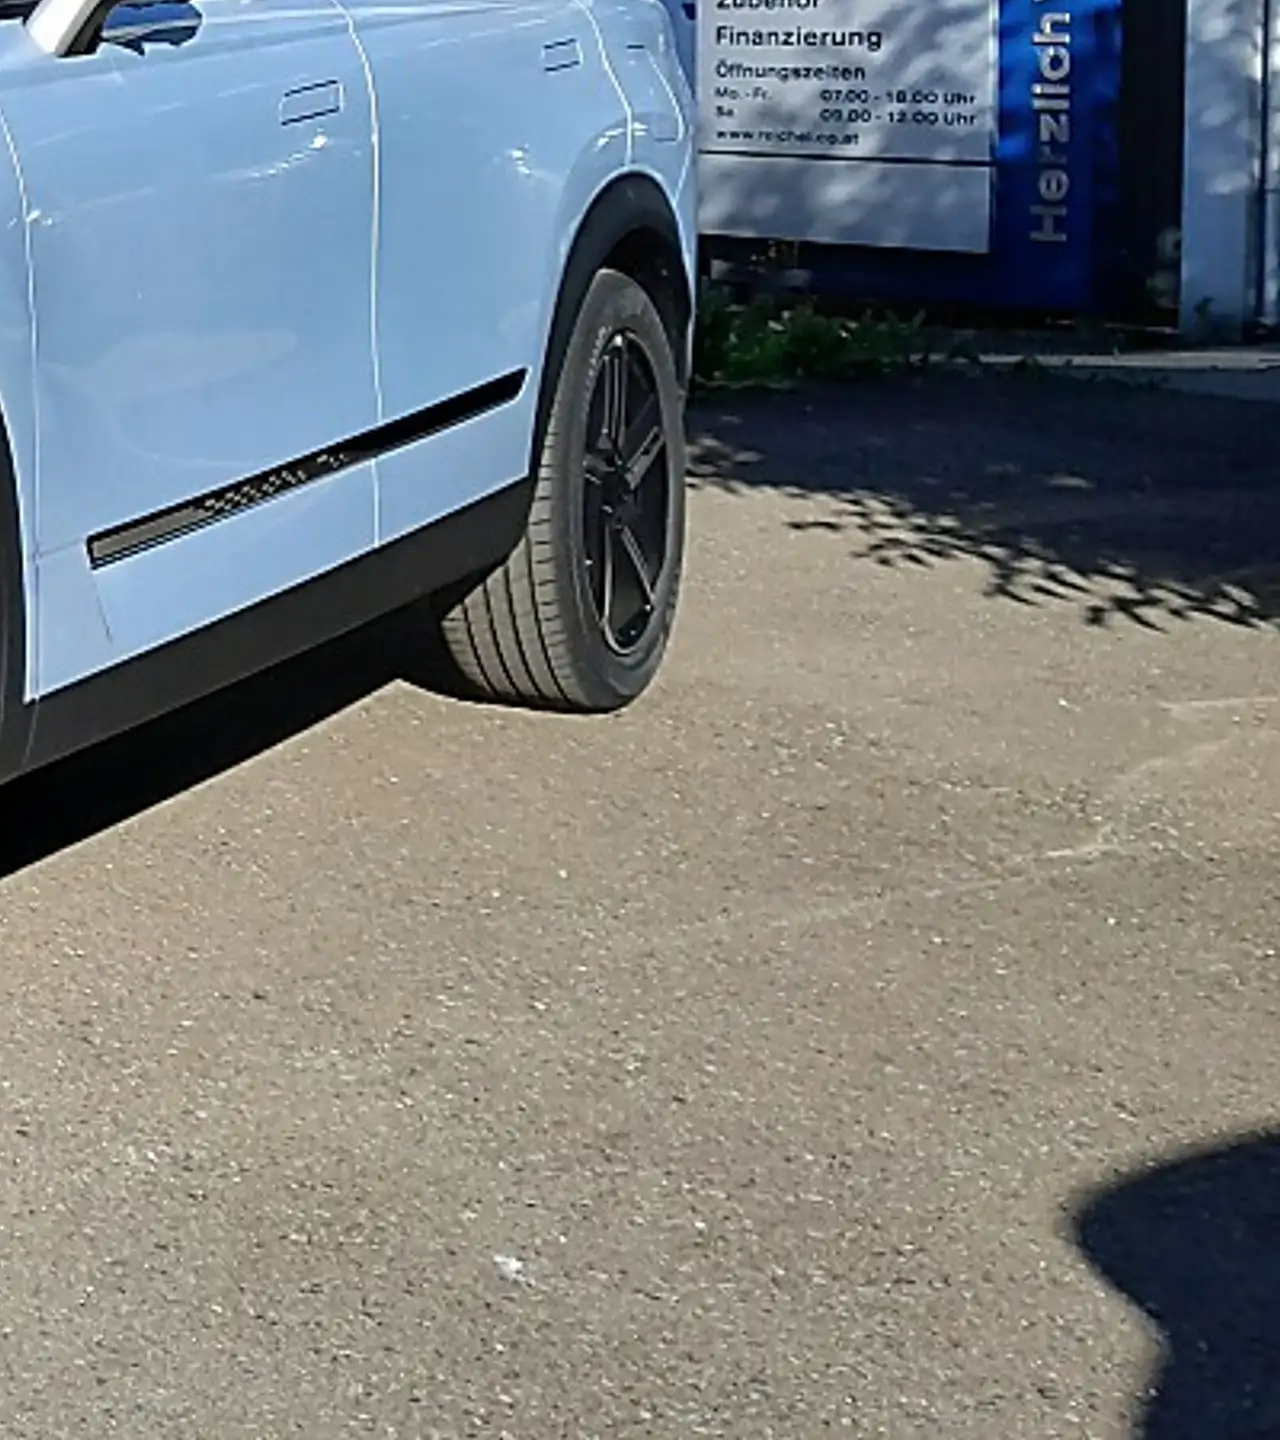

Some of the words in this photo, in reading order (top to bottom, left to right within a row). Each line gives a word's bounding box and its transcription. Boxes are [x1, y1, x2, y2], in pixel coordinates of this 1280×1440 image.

[716, 24, 884, 52] Finanzierung
[943, 91, 977, 106] Uhr
[943, 111, 977, 126] Uhr
[1031, 12, 1071, 242] Herzlich
